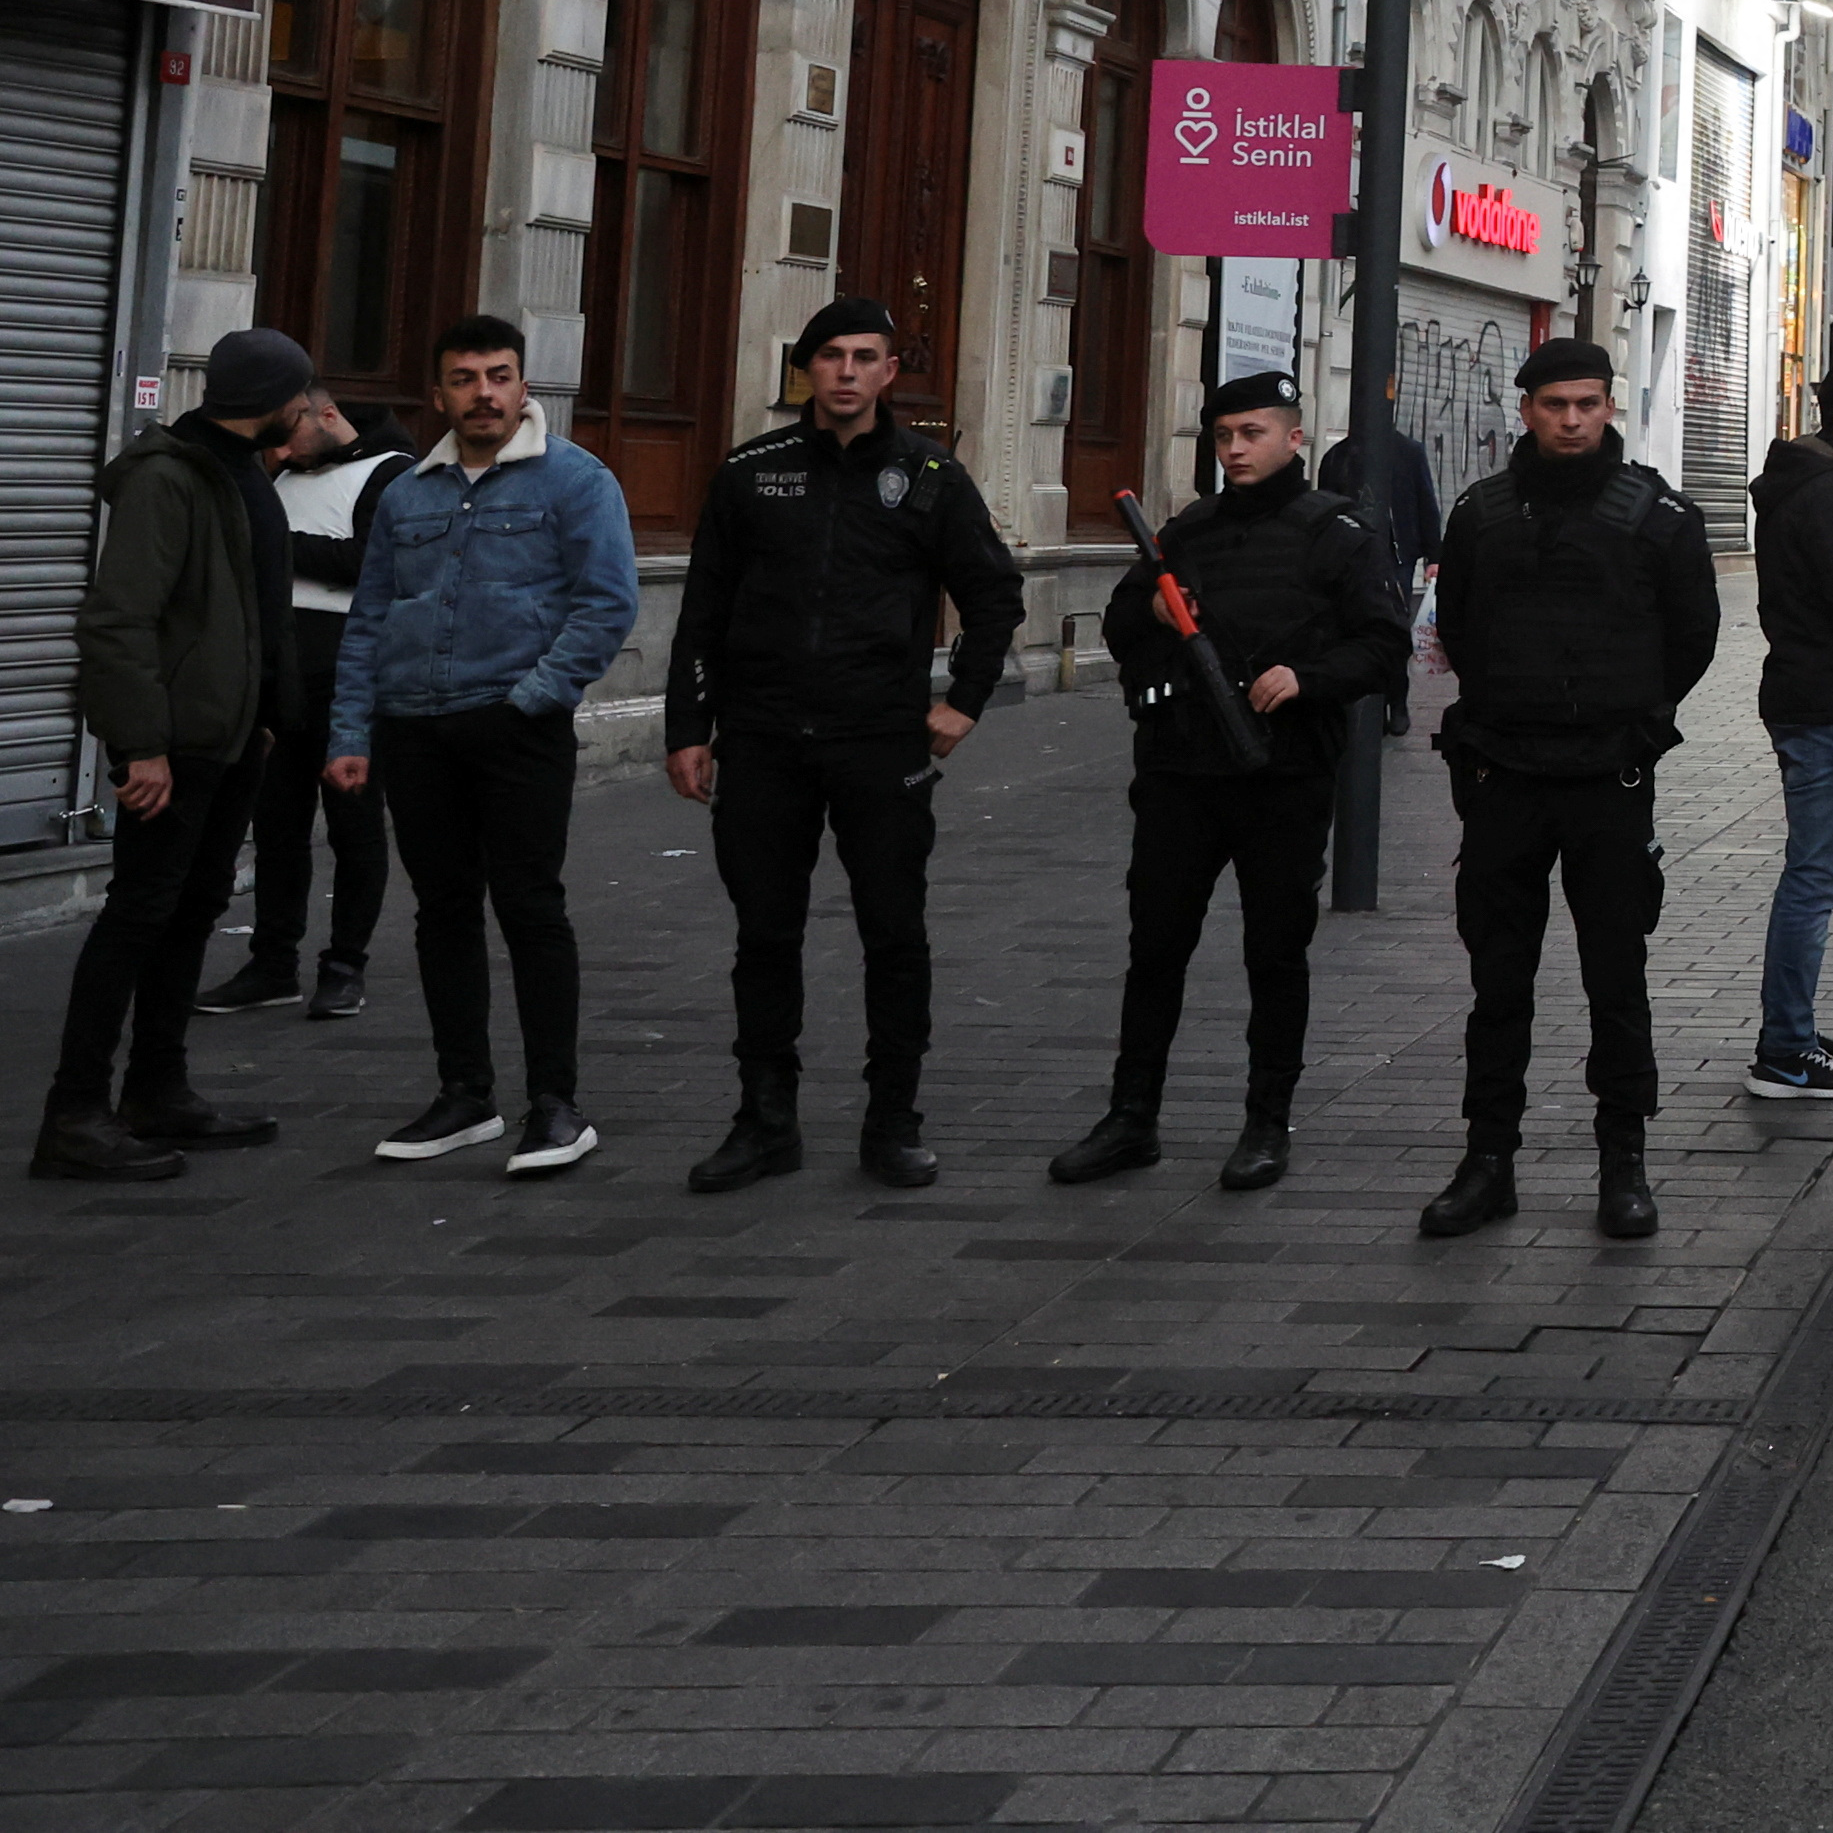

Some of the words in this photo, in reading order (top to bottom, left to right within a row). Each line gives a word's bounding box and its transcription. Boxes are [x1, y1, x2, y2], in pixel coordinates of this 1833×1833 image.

[169, 59, 184, 75] 92
[1234, 107, 1326, 140] İstiklal
[1231, 141, 1312, 167] Senin
[1234, 211, 1310, 227] istiklal.ist
[1453, 184, 1542, 254] vodafone
